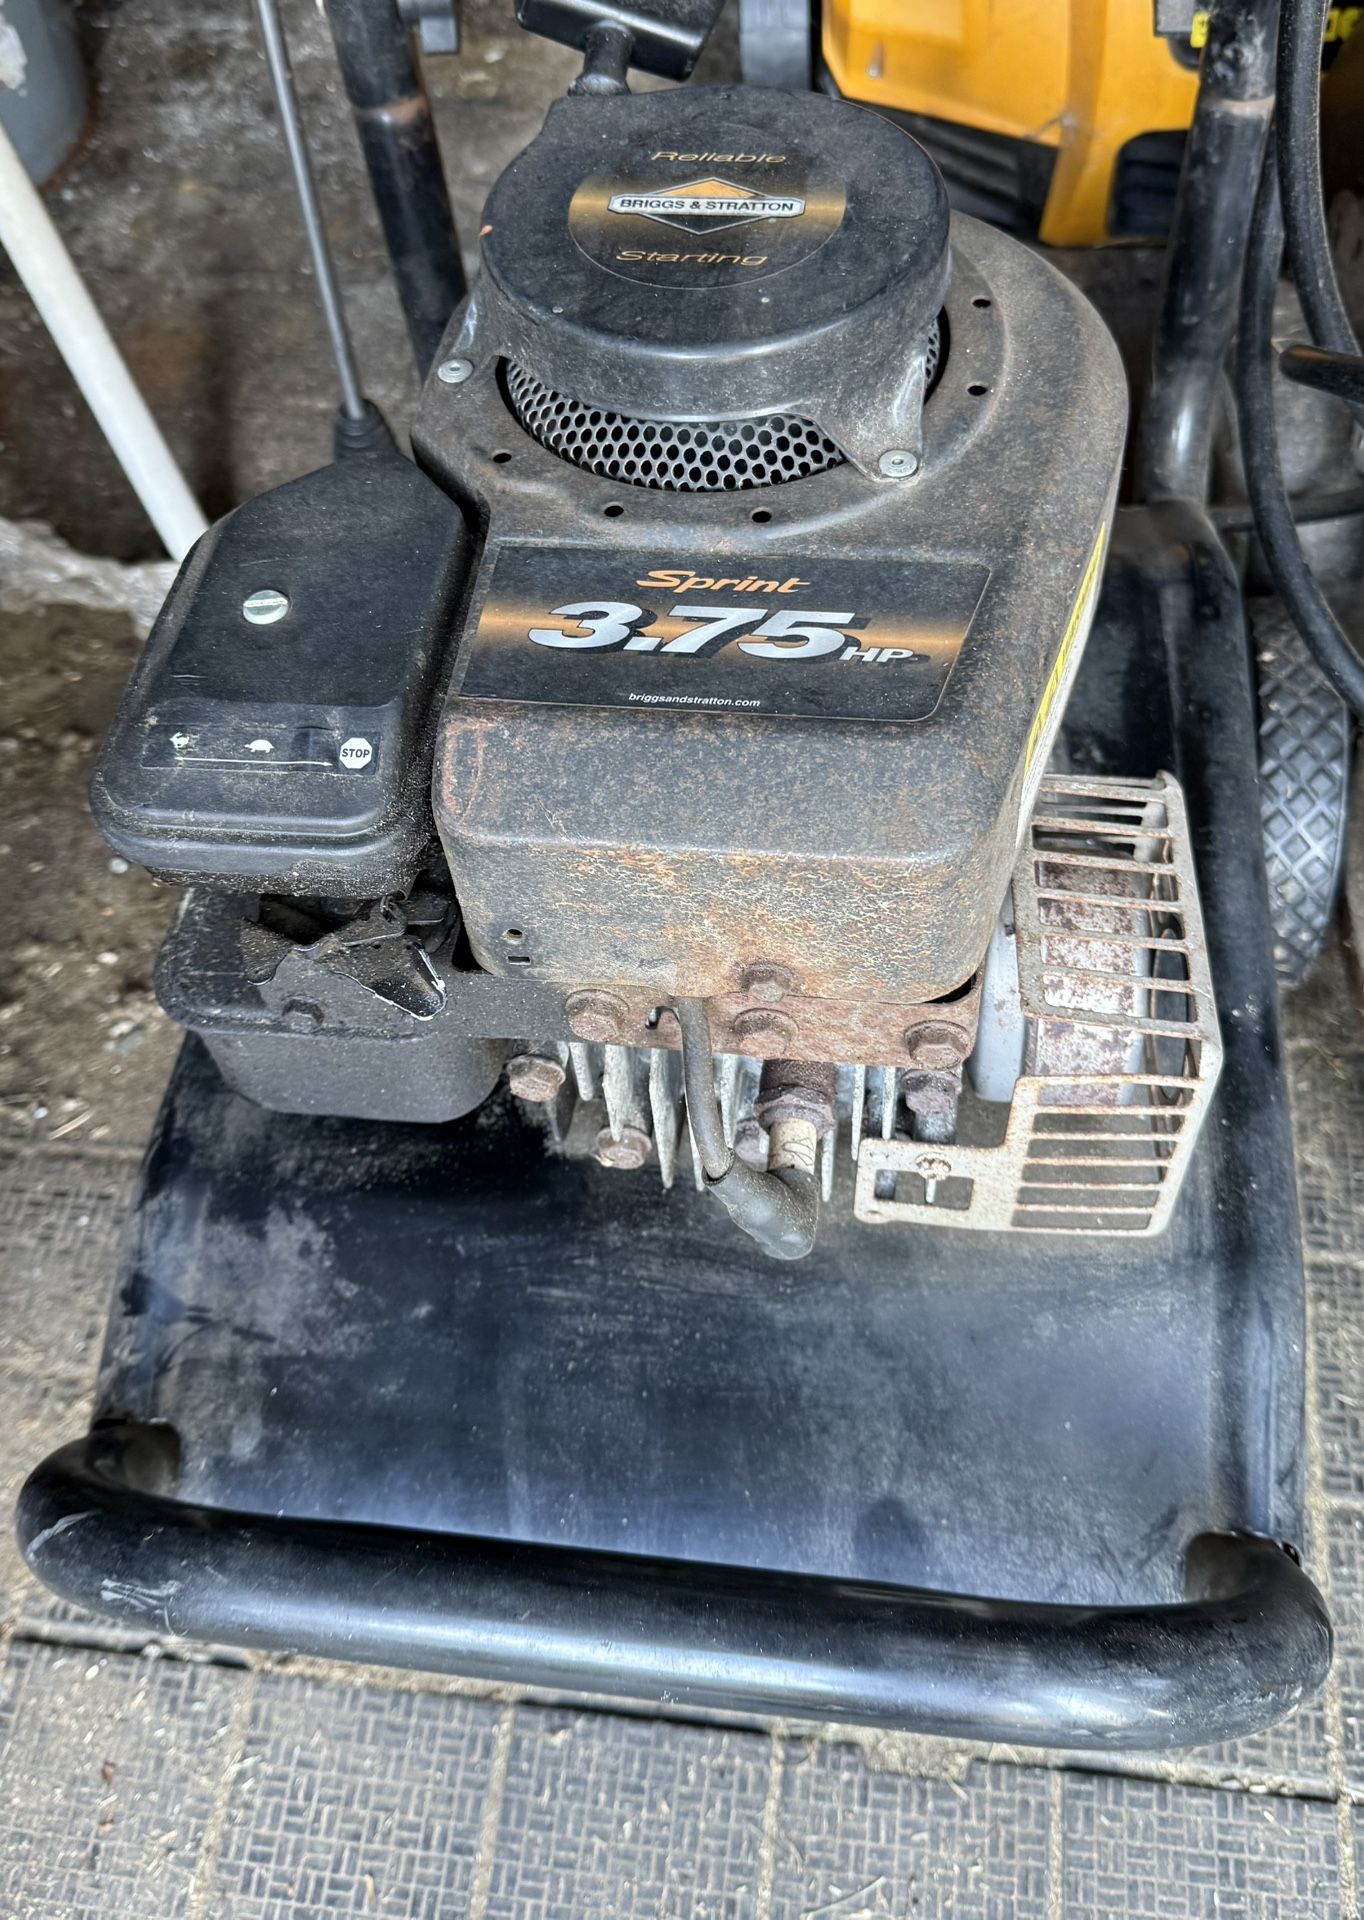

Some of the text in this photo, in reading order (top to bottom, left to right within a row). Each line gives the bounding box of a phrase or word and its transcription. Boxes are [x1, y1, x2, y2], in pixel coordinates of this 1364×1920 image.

[651, 152, 786, 163] Reliable
[619, 199, 793, 212] BRIGGS & STRATTON
[616, 251, 768, 266] Starting
[636, 570, 811, 594] Sprint
[528, 601, 916, 663] 3.75 HP
[628, 692, 761, 708] briggsandstratton.com
[341, 748, 370, 758] STOP
